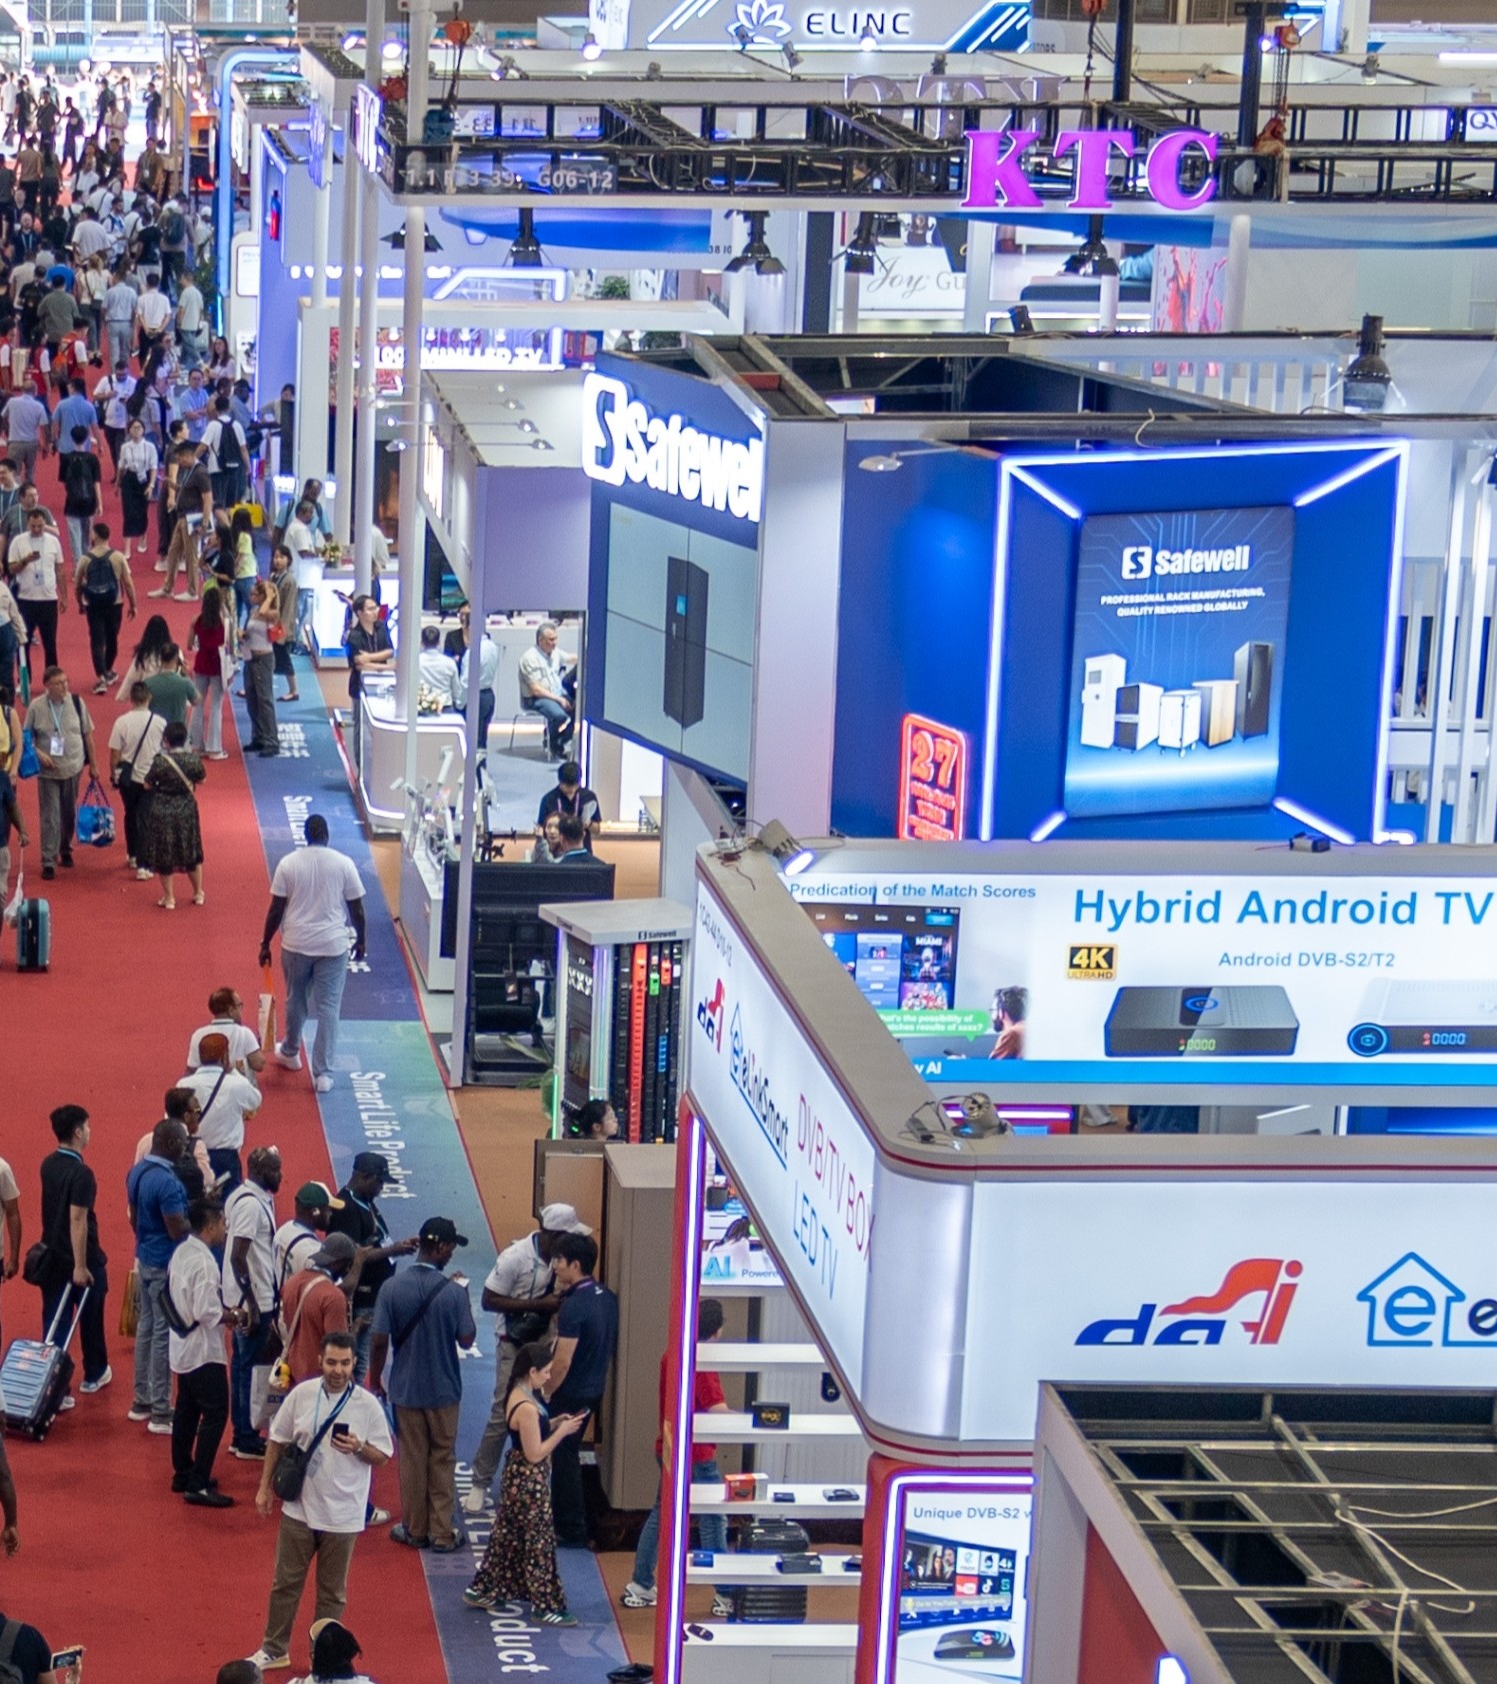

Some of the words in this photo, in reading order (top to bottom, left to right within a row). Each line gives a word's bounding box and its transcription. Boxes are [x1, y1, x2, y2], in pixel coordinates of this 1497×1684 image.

[806, 11, 911, 36] ELINC
[537, 170, 614, 188] G06-12
[961, 129, 1219, 211] KTC
[1154, 544, 1251, 577] Safewell
[1100, 592, 1166, 607] PROFESSIONAL
[1166, 591, 1191, 604] RACK
[1190, 586, 1266, 602] MANUFACTURING,
[1116, 605, 1154, 618] QUALITY
[1203, 600, 1249, 613] GLOBALLY
[909, 730, 959, 790] 27
[789, 882, 877, 898] Predication
[883, 883, 899, 898] of
[902, 884, 927, 898] the
[931, 884, 978, 899] Match
[982, 885, 1036, 900] Scores
[1073, 887, 1221, 933] Hybrid
[1235, 889, 1419, 926] Android
[1434, 891, 1497, 926] TV
[1072, 946, 1111, 970] 4K
[1218, 950, 1292, 969] Android
[1297, 951, 1396, 971] DVB-S2/T2
[925, 1061, 942, 1075] AI
[349, 1070, 397, 1111] Smart
[361, 1109, 403, 1140] Life
[913, 1506, 963, 1524] Unique
[966, 1506, 1021, 1520] DVB-S2
